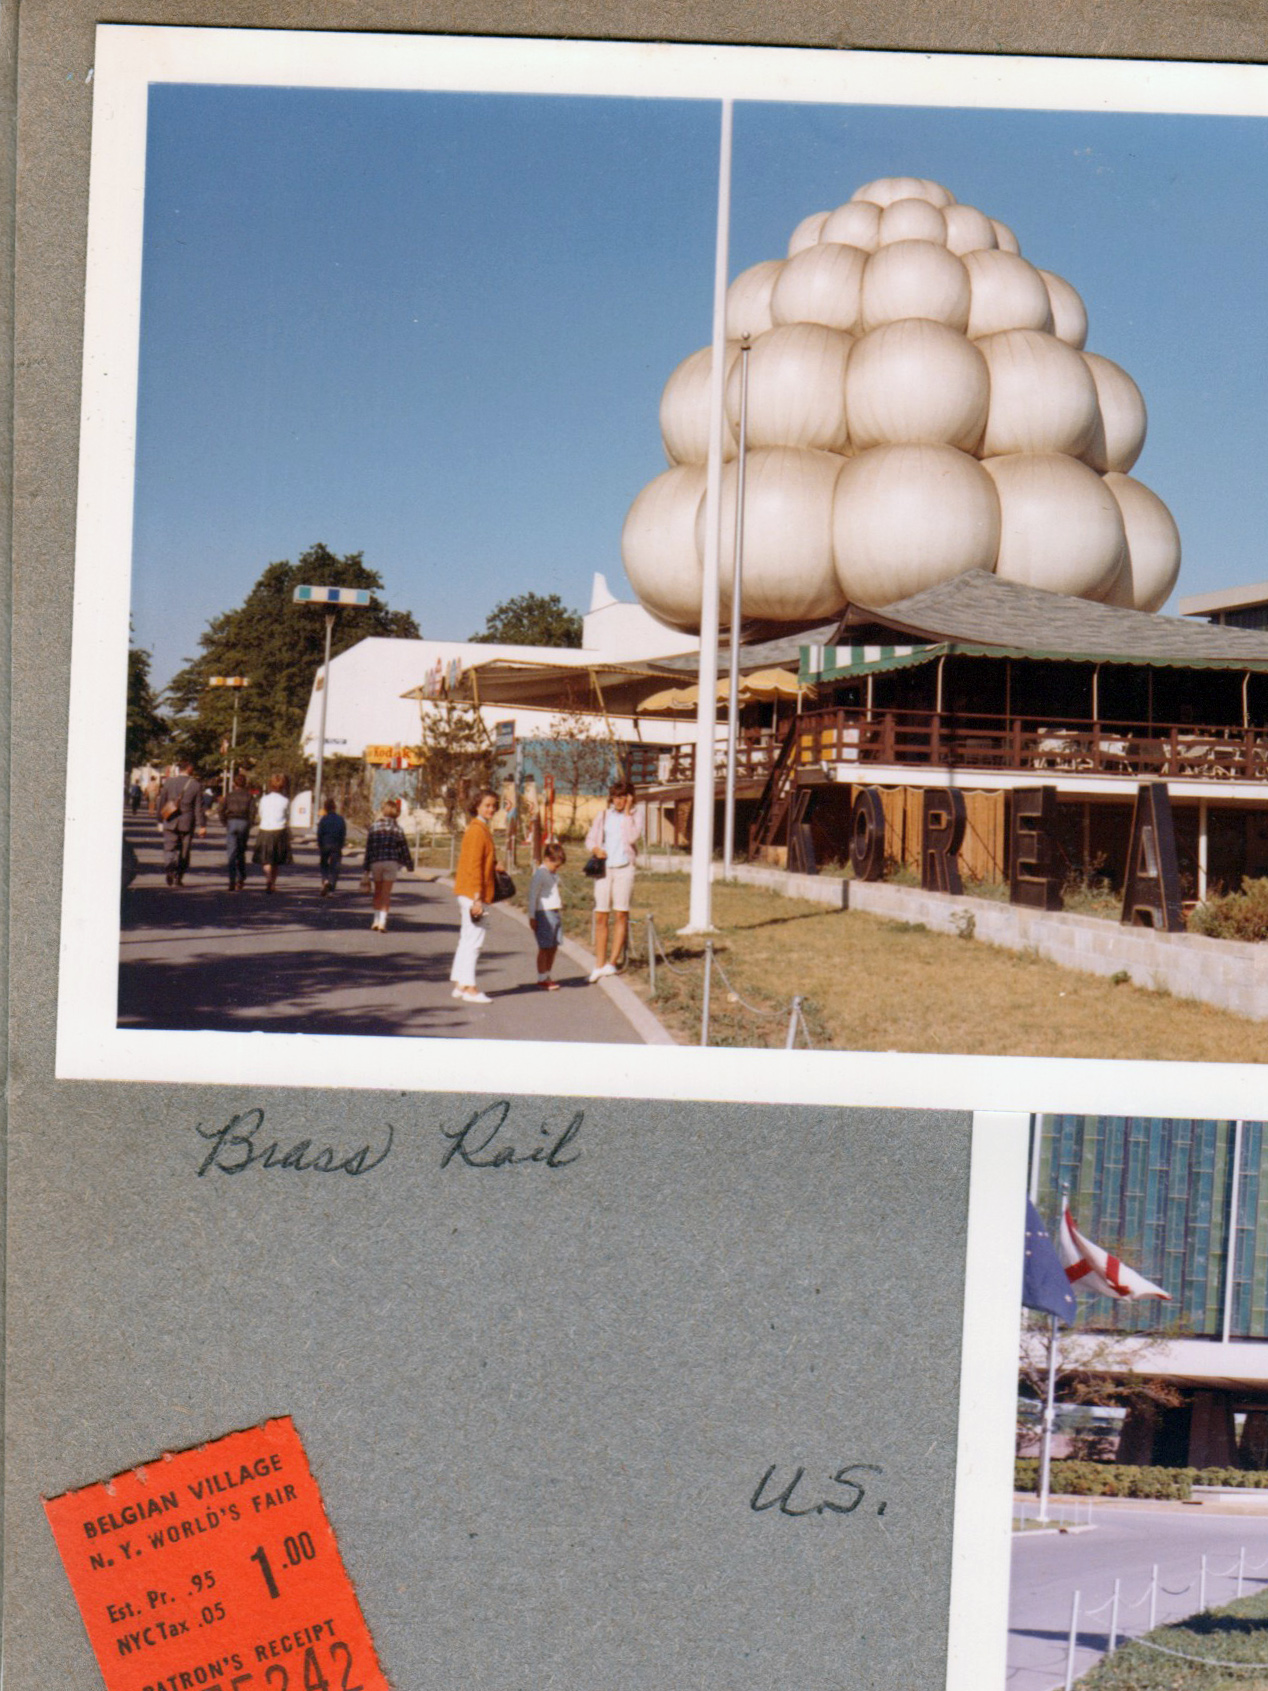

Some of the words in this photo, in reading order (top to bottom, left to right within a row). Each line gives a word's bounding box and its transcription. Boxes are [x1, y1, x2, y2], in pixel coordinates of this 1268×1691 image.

[786, 783, 1188, 933] KOREA
[197, 1107, 394, 1177] Brass
[439, 1100, 584, 1170] Rail
[83, 1491, 178, 1540] BELGIAN
[188, 1454, 284, 1500] VILLAGE
[90, 1552, 115, 1570] N.
[119, 1541, 143, 1561] Y.
[150, 1503, 241, 1550] WORLD'S
[252, 1484, 298, 1514] FAIR
[107, 1600, 142, 1623] Est.
[147, 1588, 176, 1611] Pr.
[188, 1570, 217, 1597] .95
[117, 1625, 161, 1656] NYC
[159, 1616, 190, 1640] Tax
[198, 1602, 227, 1628] .05
[256, 1619, 337, 1663] RECEIPT
